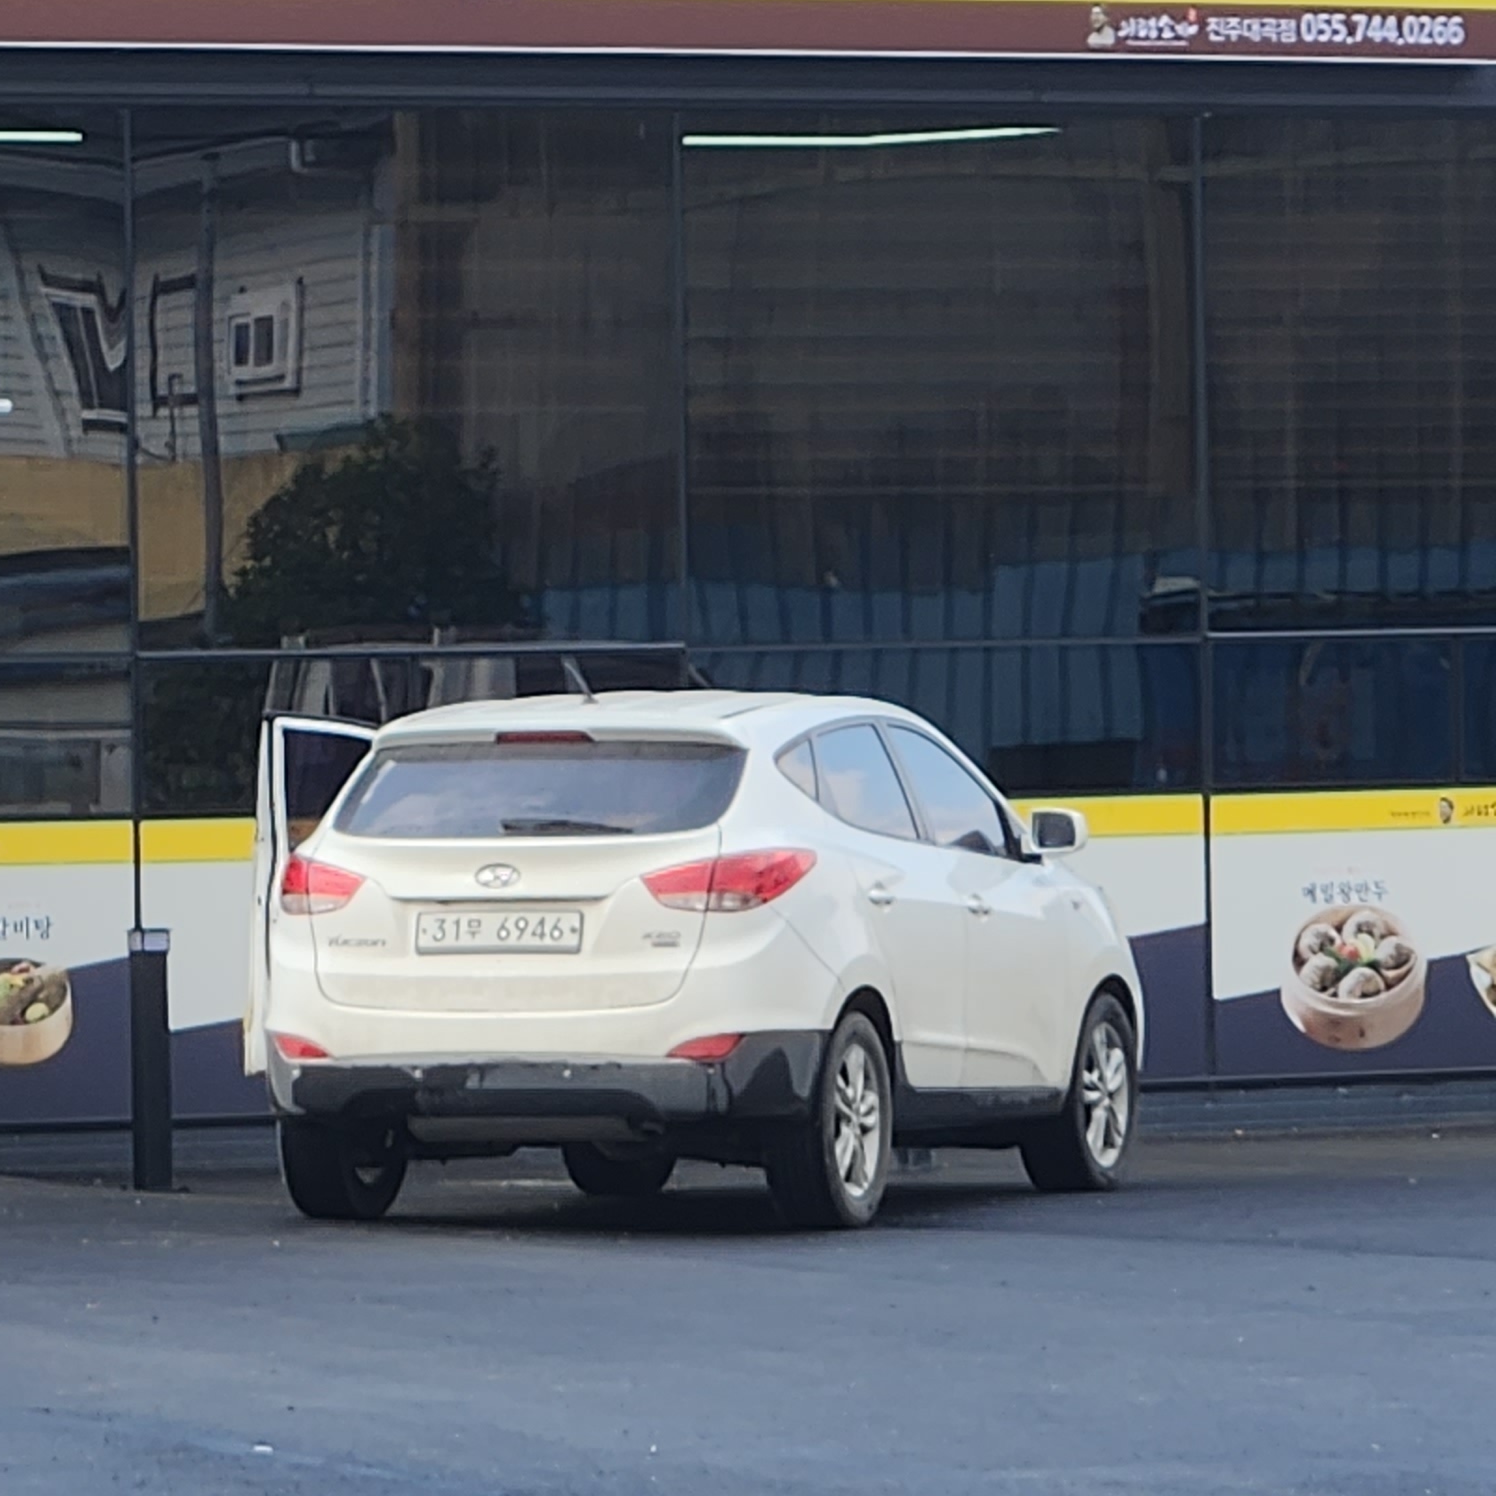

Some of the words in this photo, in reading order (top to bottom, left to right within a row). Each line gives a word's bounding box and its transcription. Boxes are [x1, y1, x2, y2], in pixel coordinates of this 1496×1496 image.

[1206, 16, 1297, 43] 진주대곡점
[1301, 12, 1466, 47] 055.744.0266
[431, 917, 482, 943] 31무
[496, 916, 565, 942] 6946
